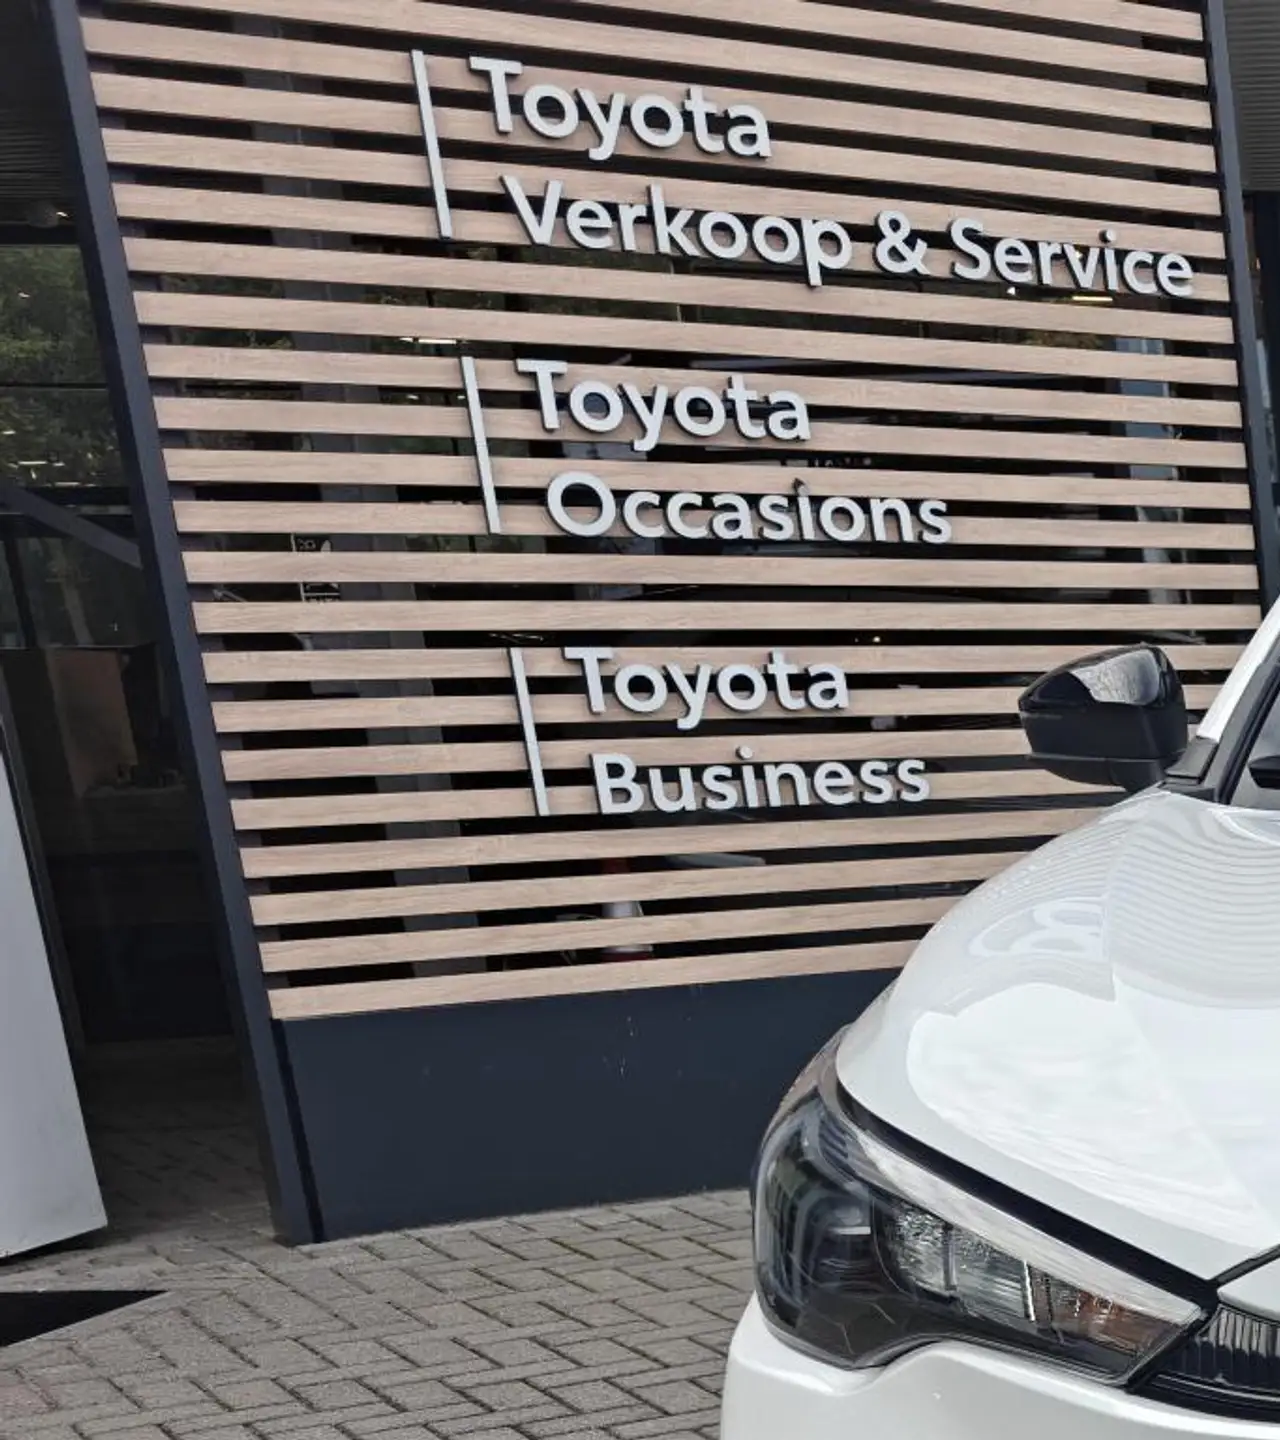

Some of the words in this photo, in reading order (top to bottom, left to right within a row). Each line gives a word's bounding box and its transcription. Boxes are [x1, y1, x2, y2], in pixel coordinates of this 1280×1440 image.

[468, 56, 772, 161] Toyota
[500, 175, 852, 287] Verkoop
[875, 210, 932, 276] &
[948, 217, 1194, 297] Service
[515, 357, 812, 452] Toyota
[547, 470, 954, 545] Occasions
[563, 646, 849, 730] Toyota
[590, 745, 931, 815] Business
